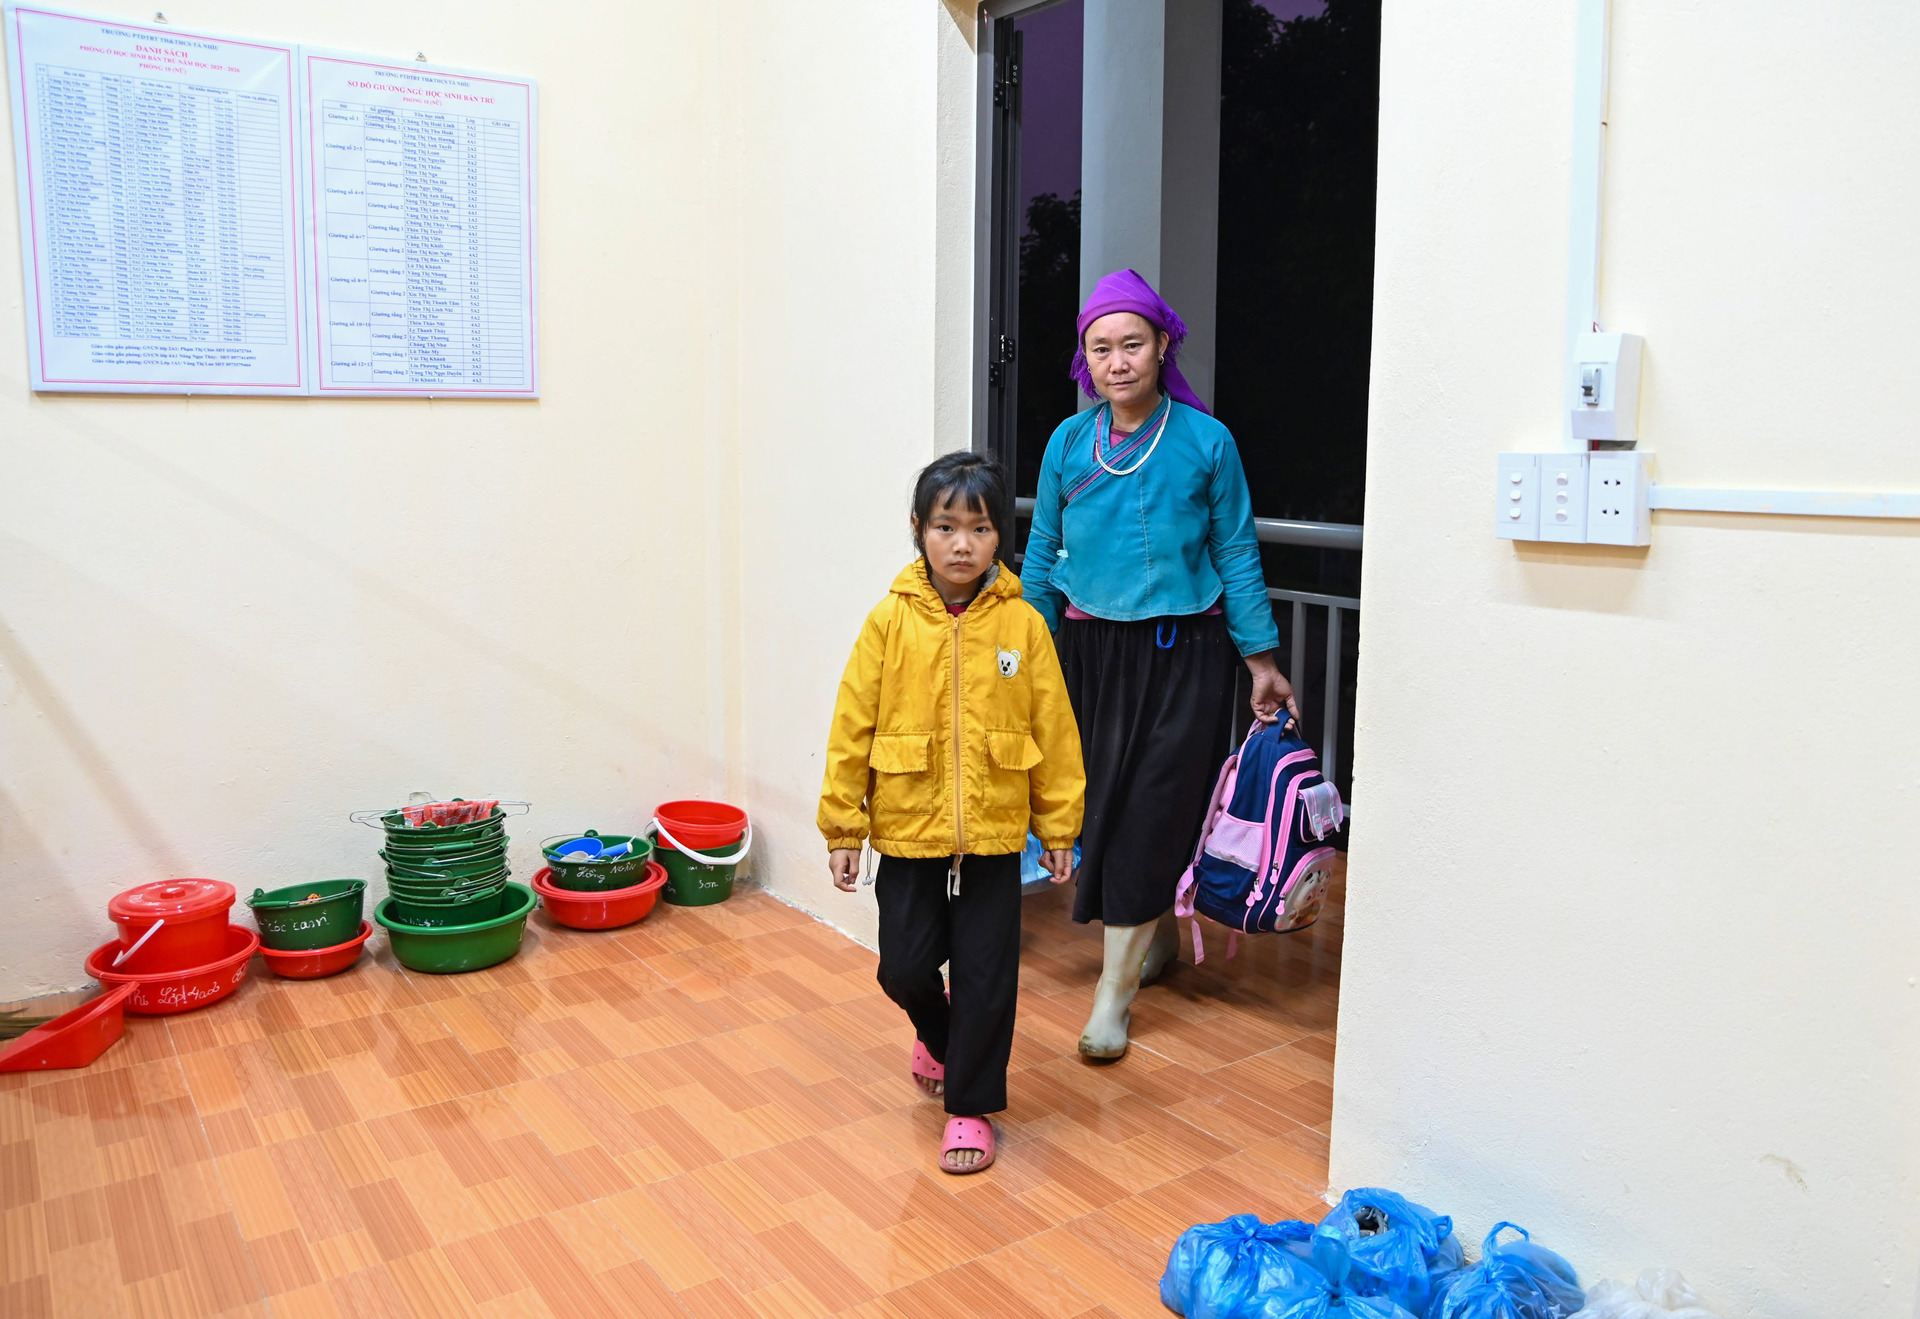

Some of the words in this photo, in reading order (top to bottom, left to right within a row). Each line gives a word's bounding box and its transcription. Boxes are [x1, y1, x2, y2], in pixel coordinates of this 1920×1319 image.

[80, 45, 105, 54] PHÒNG
[136, 45, 162, 55] DANH
[164, 48, 188, 59] SÁCH
[140, 63, 163, 71] PHÒNG
[360, 80, 372, 90] ĐỒ
[373, 83, 406, 94] GIƯỜNG
[426, 90, 443, 100] HỌC
[444, 92, 462, 100] SINH
[464, 93, 480, 102] BÁN
[481, 95, 496, 104] TRÚ
